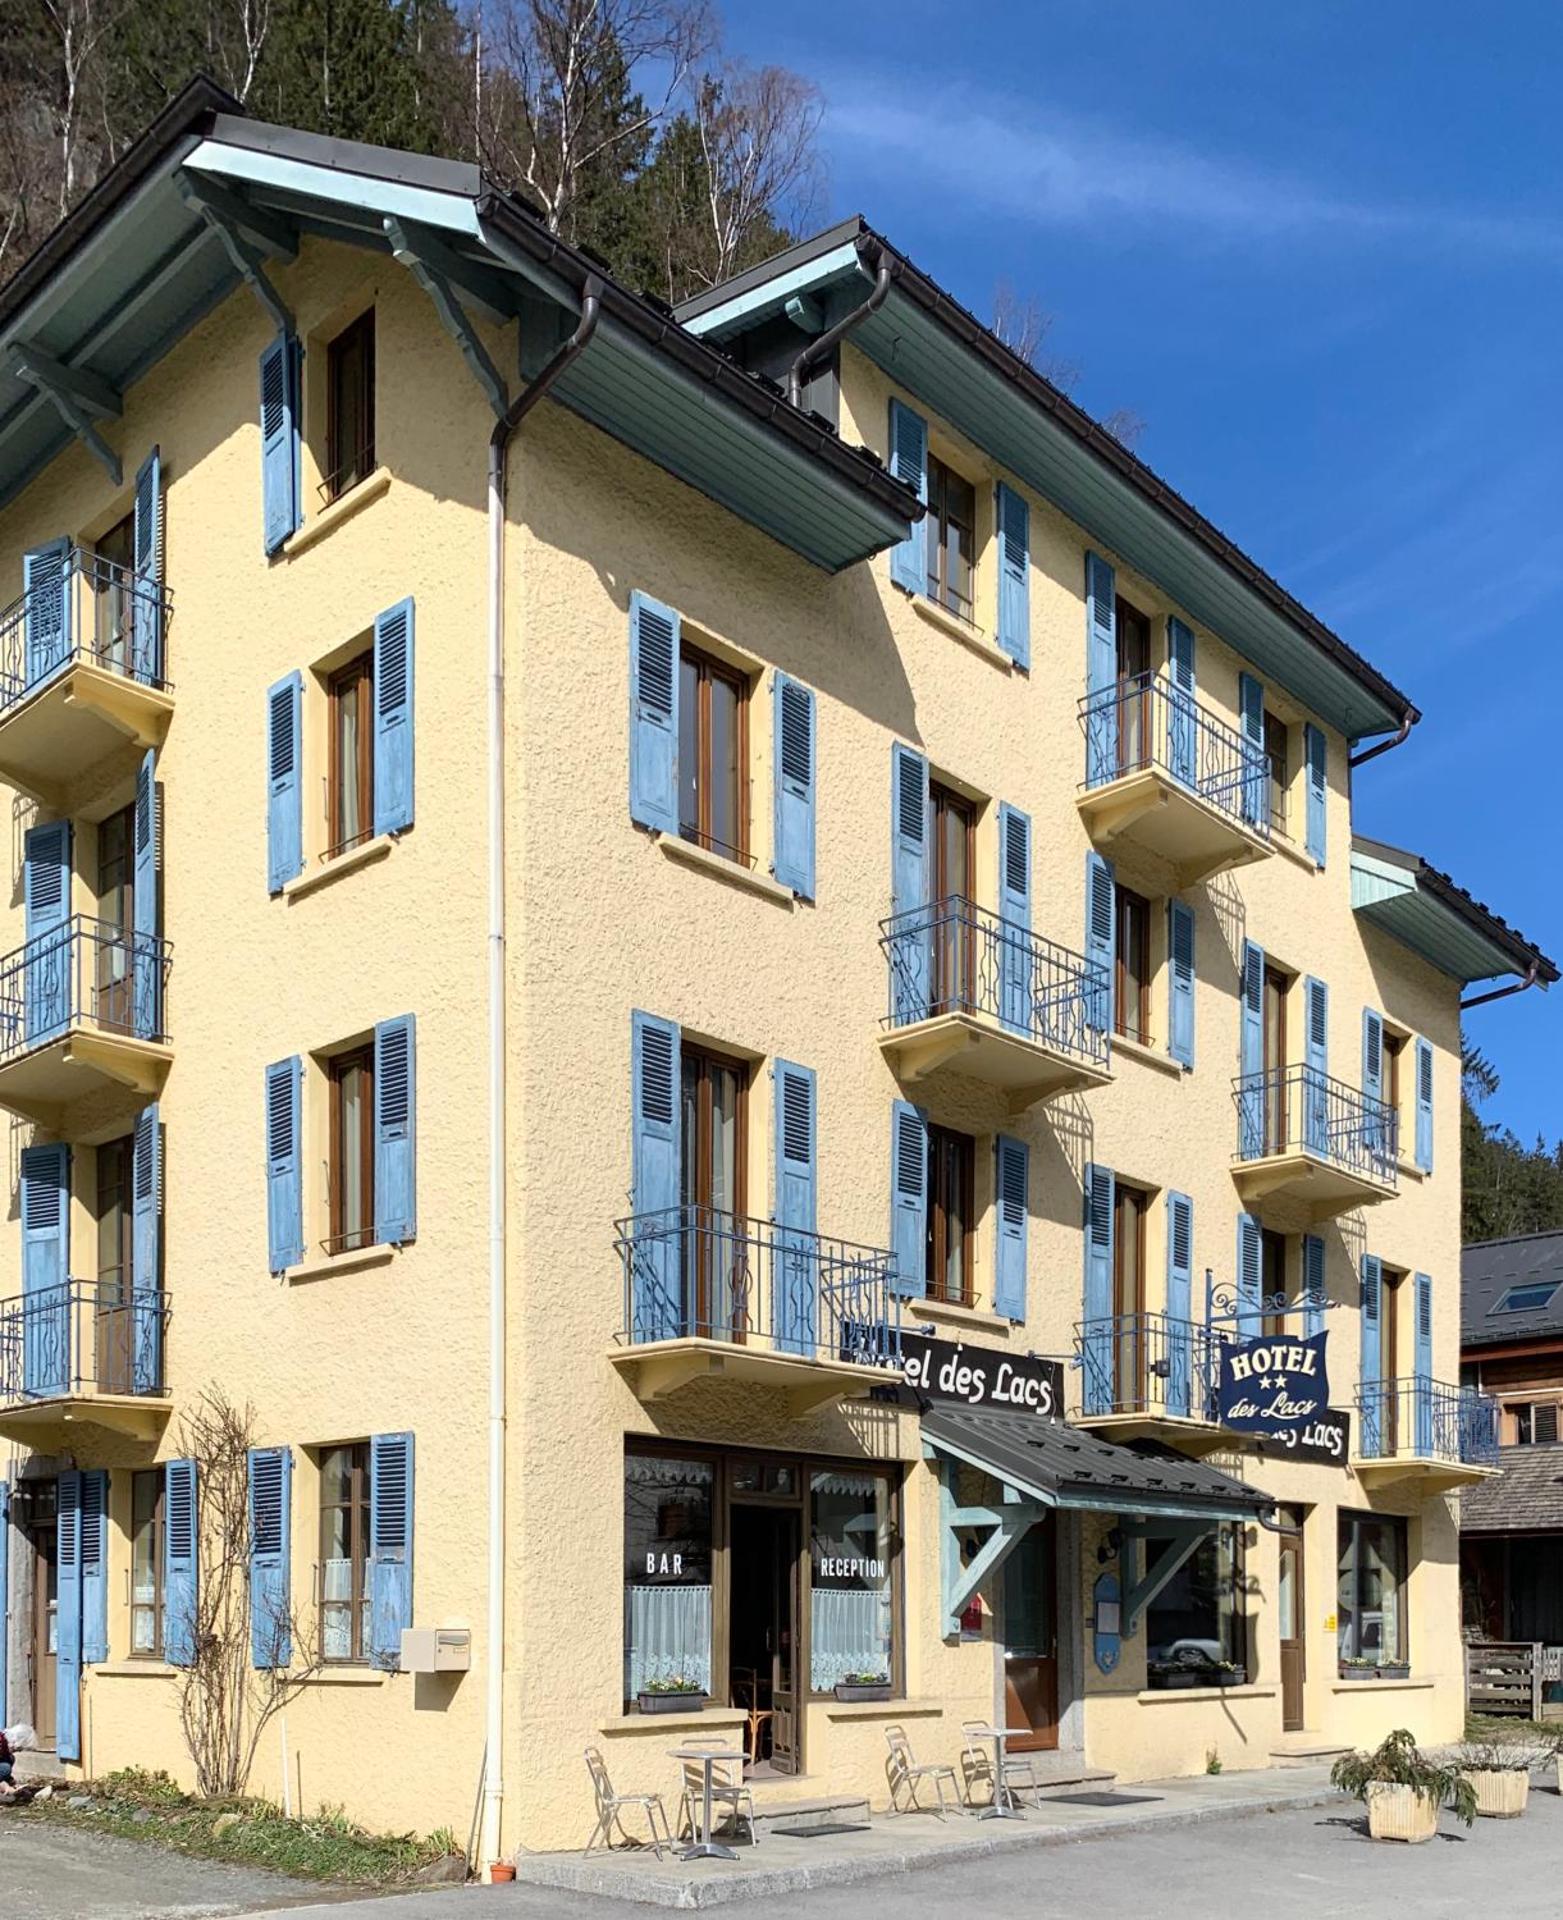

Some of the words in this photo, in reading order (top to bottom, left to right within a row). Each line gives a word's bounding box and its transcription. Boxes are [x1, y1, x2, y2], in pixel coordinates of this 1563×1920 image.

[1230, 1345, 1317, 1381] HOTEL
[939, 1354, 986, 1404] des
[991, 1362, 1052, 1415] Lacs
[1227, 1397, 1259, 1418] des
[1260, 1391, 1318, 1420] Lacs
[646, 1552, 682, 1575] BAR
[821, 1557, 885, 1578] RECEPTION
